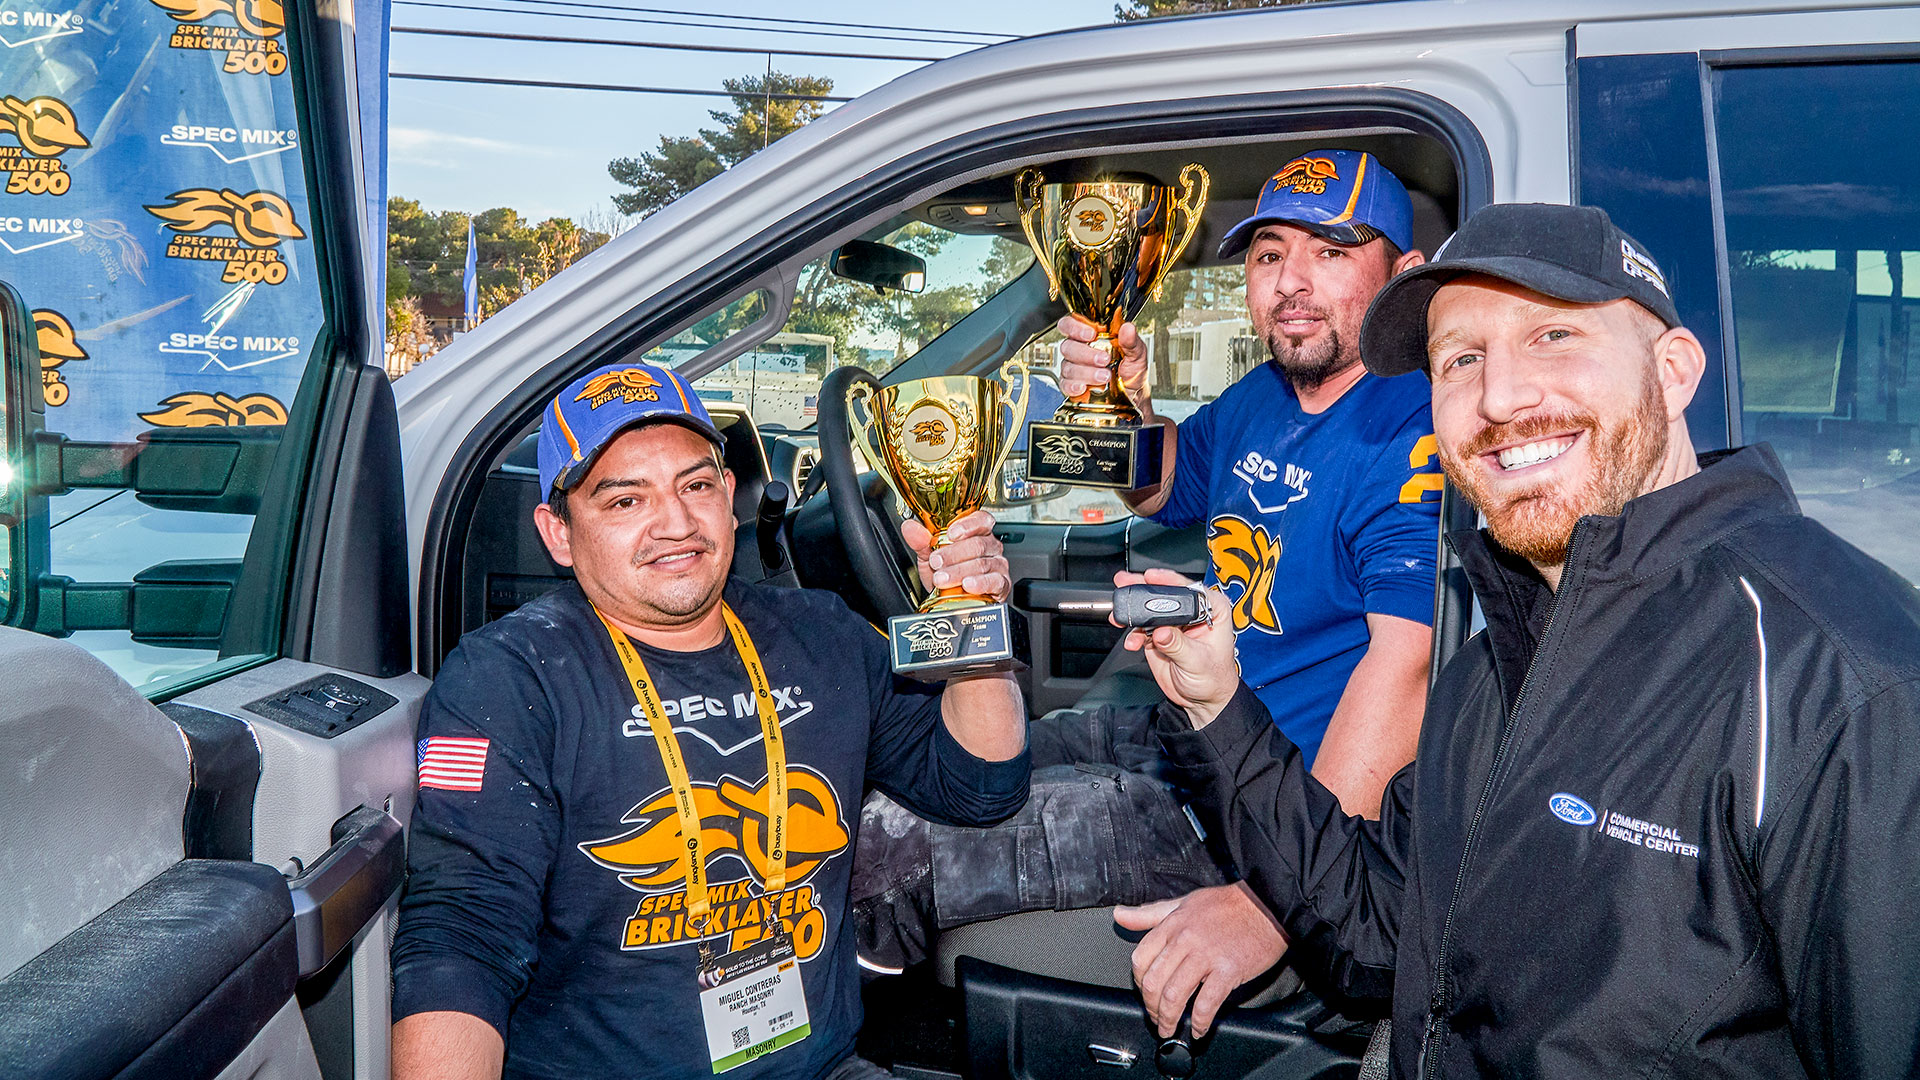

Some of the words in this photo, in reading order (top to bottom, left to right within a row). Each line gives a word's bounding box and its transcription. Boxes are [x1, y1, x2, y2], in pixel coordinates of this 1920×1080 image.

[177, 24, 208, 36] SPEC
[213, 27, 239, 37] MIX
[170, 35, 279, 52] BRICKLAYER
[223, 50, 287, 75] 500
[171, 125, 237, 143] SPEC
[6, 171, 70, 195] 500
[1291, 184, 1325, 194] 500
[174, 235, 207, 246] SPEC
[211, 238, 239, 248] MIX
[167, 245, 278, 262] BRICKLAYER
[222, 261, 287, 285] 500
[169, 333, 238, 351] SPEC
[780, 356, 798, 367] 475
[623, 392, 659, 404] 500
[1088, 439, 1127, 449] CHAMPION
[961, 614, 997, 626] CHAMPION
[930, 647, 951, 657] 500
[1555, 798, 1584, 821] Ford
[774, 815, 783, 849] busybusy
[1609, 811, 1681, 841] COMMERCIAL
[1606, 823, 1643, 846] VEHICLE
[1645, 835, 1699, 858] CENTER
[690, 850, 699, 885] busybusy
[706, 880, 750, 906] MIX
[731, 908, 825, 959] 50
[718, 989, 744, 1006] MIGUEL
[744, 974, 782, 997] CONTRERAS
[729, 999, 748, 1012] RANCH
[748, 988, 775, 1005] MASONRY
[760, 1000, 767, 1008] TX
[745, 1038, 777, 1060] MASONRY
